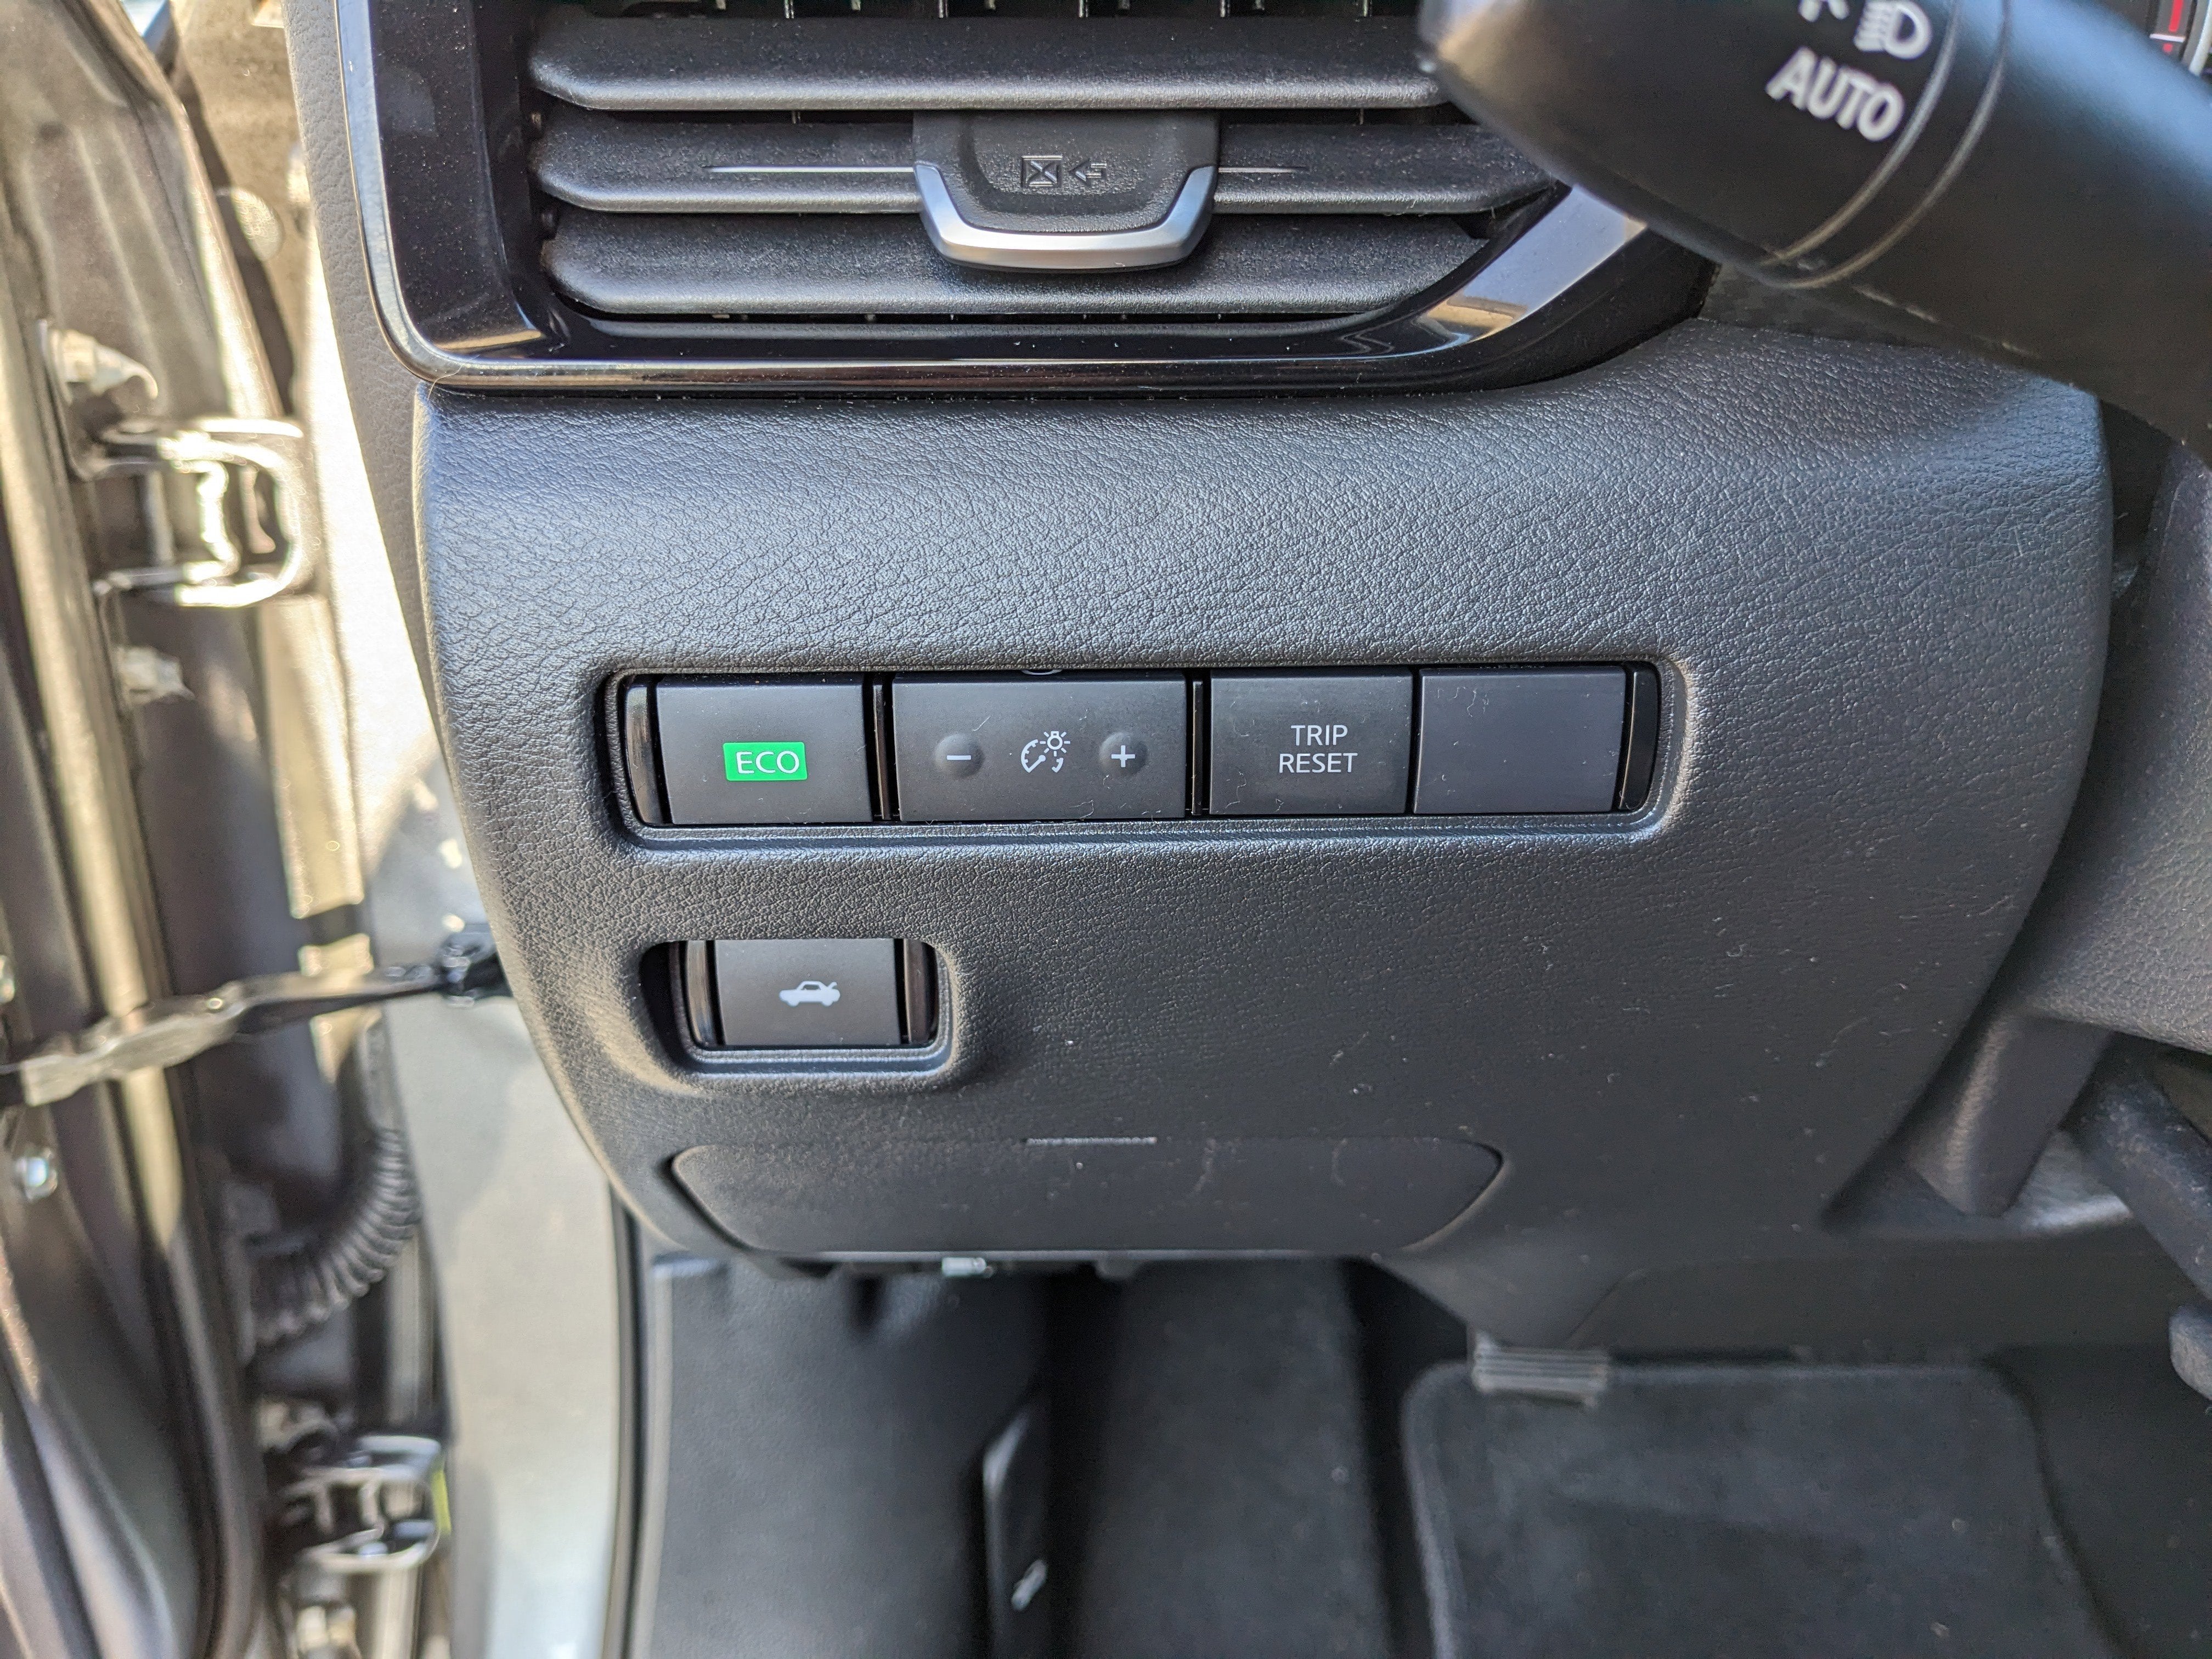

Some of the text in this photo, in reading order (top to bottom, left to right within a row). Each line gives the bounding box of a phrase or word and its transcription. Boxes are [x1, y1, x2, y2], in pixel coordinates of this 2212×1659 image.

[1767, 47, 1904, 141] AUTO
[1290, 725, 1348, 746] TRIP
[736, 751, 800, 774] ECO
[1279, 753, 1358, 774] RESET
